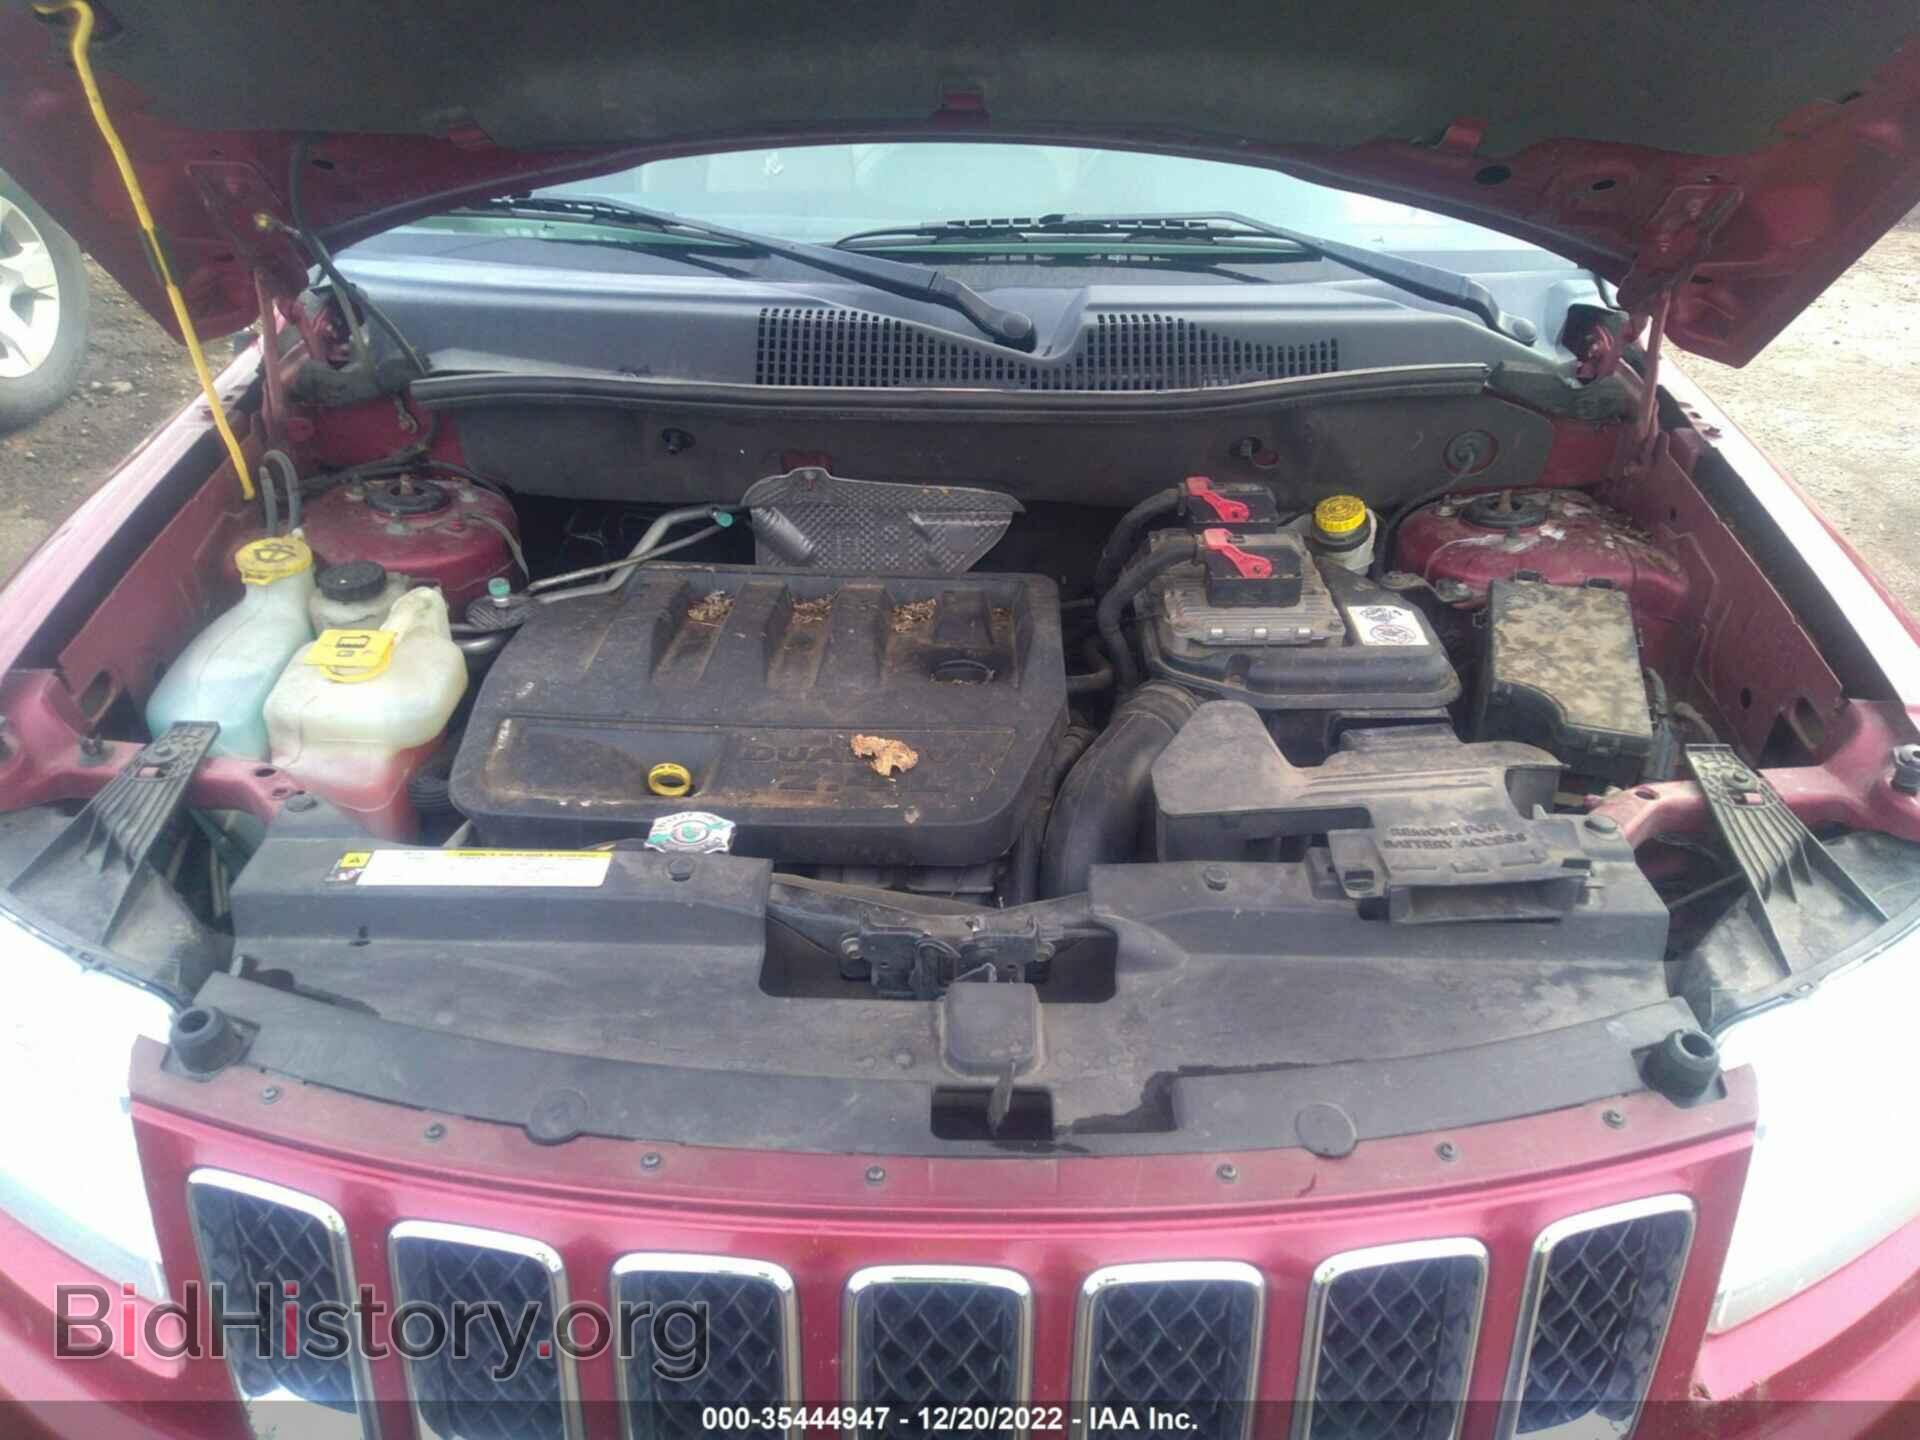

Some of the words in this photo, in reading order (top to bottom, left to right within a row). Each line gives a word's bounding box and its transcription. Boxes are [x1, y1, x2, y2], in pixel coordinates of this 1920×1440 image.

[1389, 826, 1461, 837] REMOVE
[1464, 823, 1501, 835] FOR
[1383, 839, 1453, 849] BATTERY
[1459, 832, 1528, 848] ACCESS
